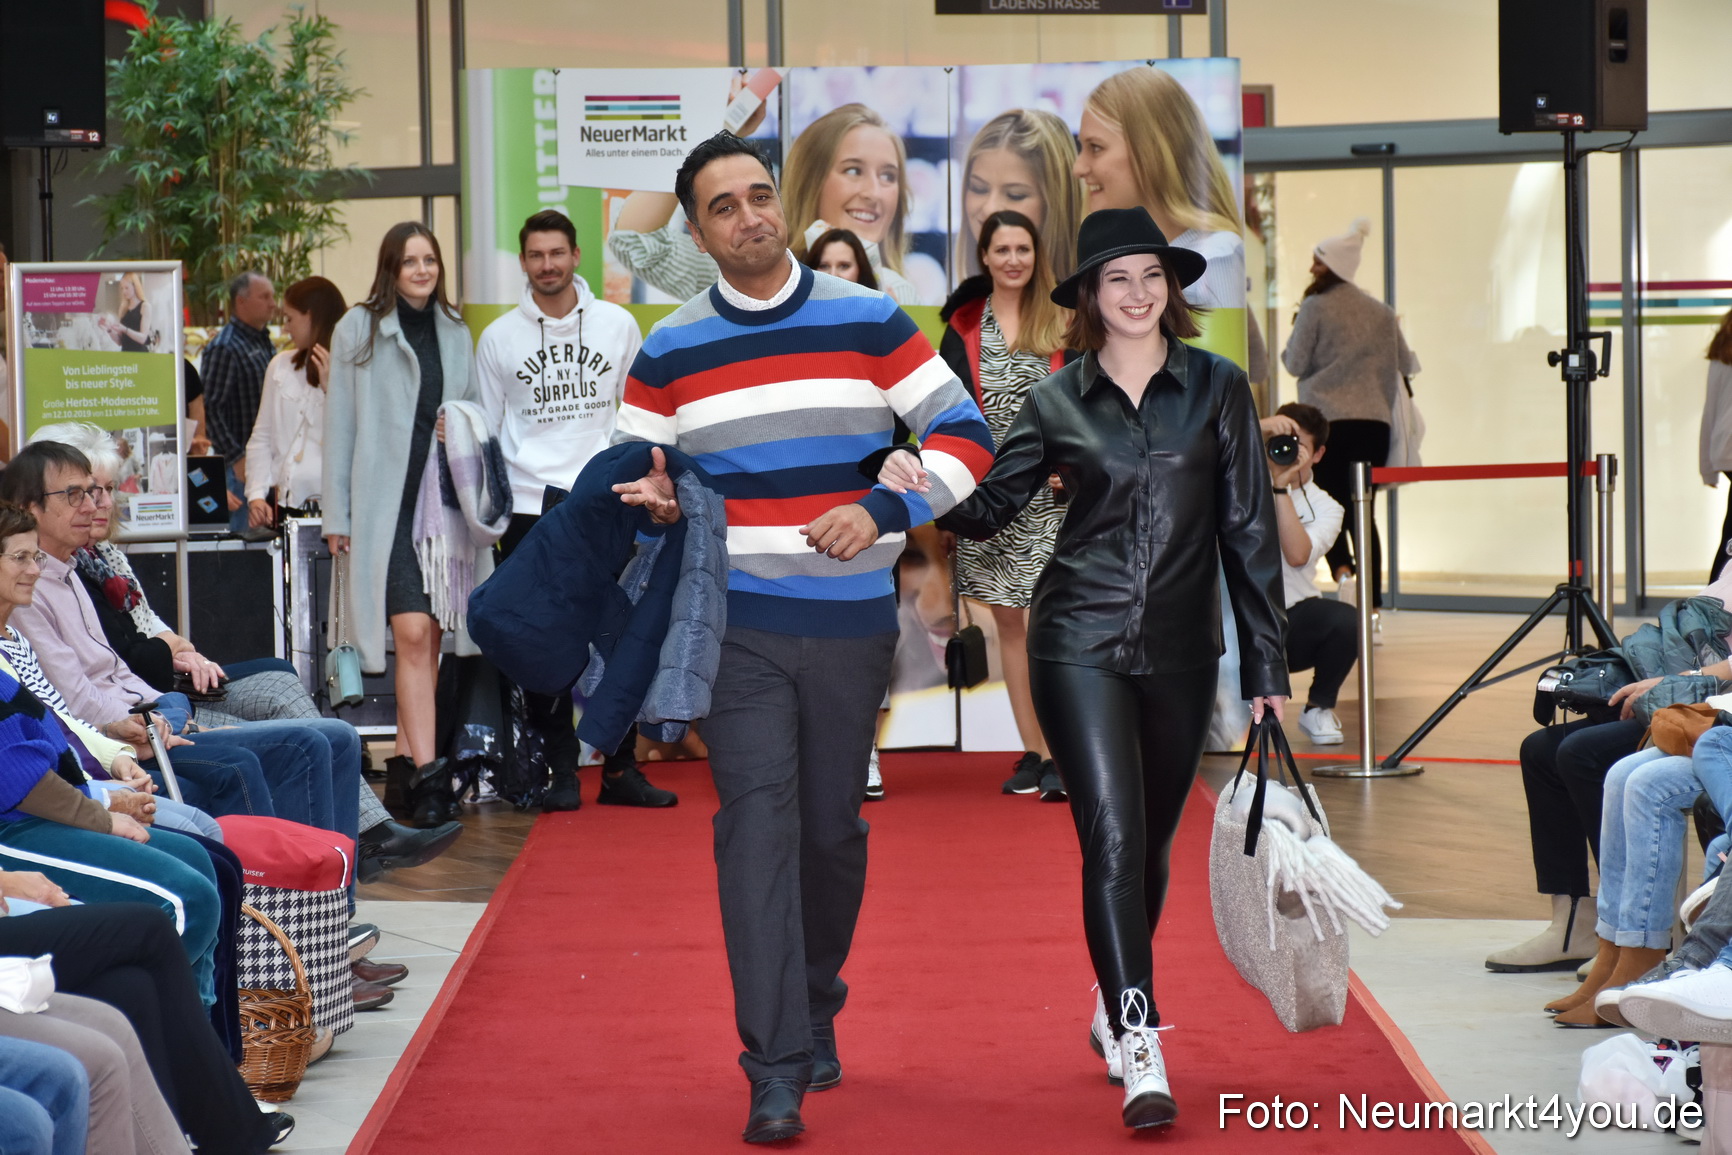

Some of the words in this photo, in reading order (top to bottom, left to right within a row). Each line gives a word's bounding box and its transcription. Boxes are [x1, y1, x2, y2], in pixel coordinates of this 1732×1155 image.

[989, 0, 1100, 9] LADENSTRASSE
[1573, 115, 1583, 125] 12
[88, 132, 99, 141] 12
[580, 125, 687, 142] NeuerMarkt
[585, 149, 605, 157] Alles
[607, 149, 629, 157] unter
[631, 148, 658, 157] einem
[660, 148, 684, 157] Dach.
[62, 366, 80, 376] Von
[82, 364, 138, 376] Lieblingsteil
[516, 344, 612, 385] SUPERDRY
[557, 369, 570, 380] NY
[65, 379, 79, 389] bis
[81, 380, 108, 389] neuer
[109, 378, 136, 390] Style.
[534, 381, 597, 403] SURPLUS
[43, 400, 65, 408] Große
[66, 396, 158, 407] Herbst-Modenschau
[521, 408, 543, 416] FIRST
[548, 404, 580, 414] GRADE
[584, 400, 611, 410] GOODS
[136, 513, 175, 521] NeuerMarkt
